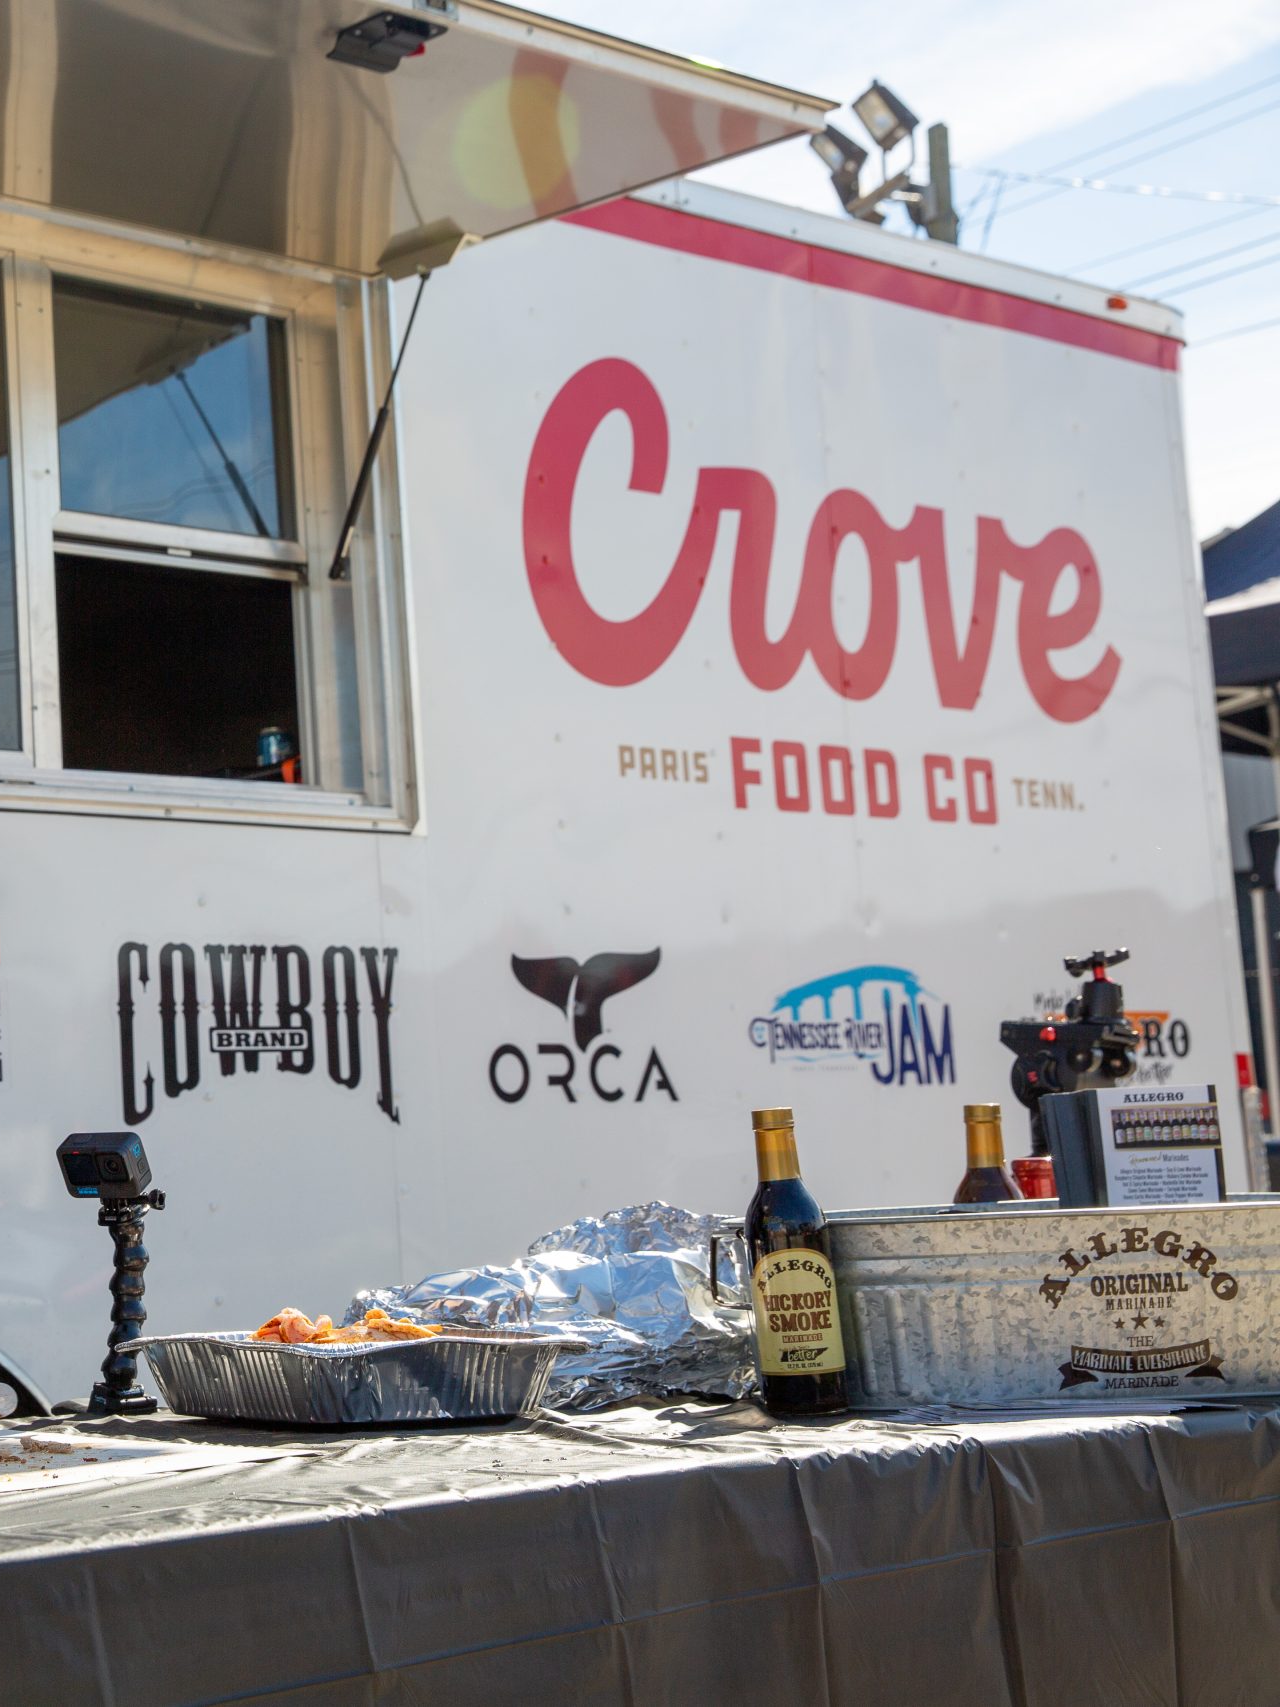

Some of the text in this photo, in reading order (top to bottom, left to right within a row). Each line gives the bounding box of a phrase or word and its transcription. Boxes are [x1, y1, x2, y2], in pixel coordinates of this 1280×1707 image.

[522, 357, 1123, 724] Crove
[618, 736, 1085, 825] PARIS FOOD CO TENN.
[118, 941, 400, 1126] COWBOY
[217, 1031, 305, 1049] BRAND
[871, 986, 956, 1086] JAM
[489, 1044, 680, 1103] ORCA
[1123, 1091, 1185, 1103] ALLEGRO
[757, 1259, 833, 1293] ALLEGRO
[1038, 1227, 1239, 1309] ALLEGRO
[1090, 1272, 1188, 1297] ORIGINAL
[762, 1290, 832, 1312] HICKORY
[1106, 1297, 1173, 1311] MARINADE
[769, 1310, 832, 1333] SMOKE
[1127, 1336, 1154, 1347] THE
[1073, 1345, 1207, 1372] MARINATE EVERYTHING
[1105, 1376, 1179, 1390] MARINADE
